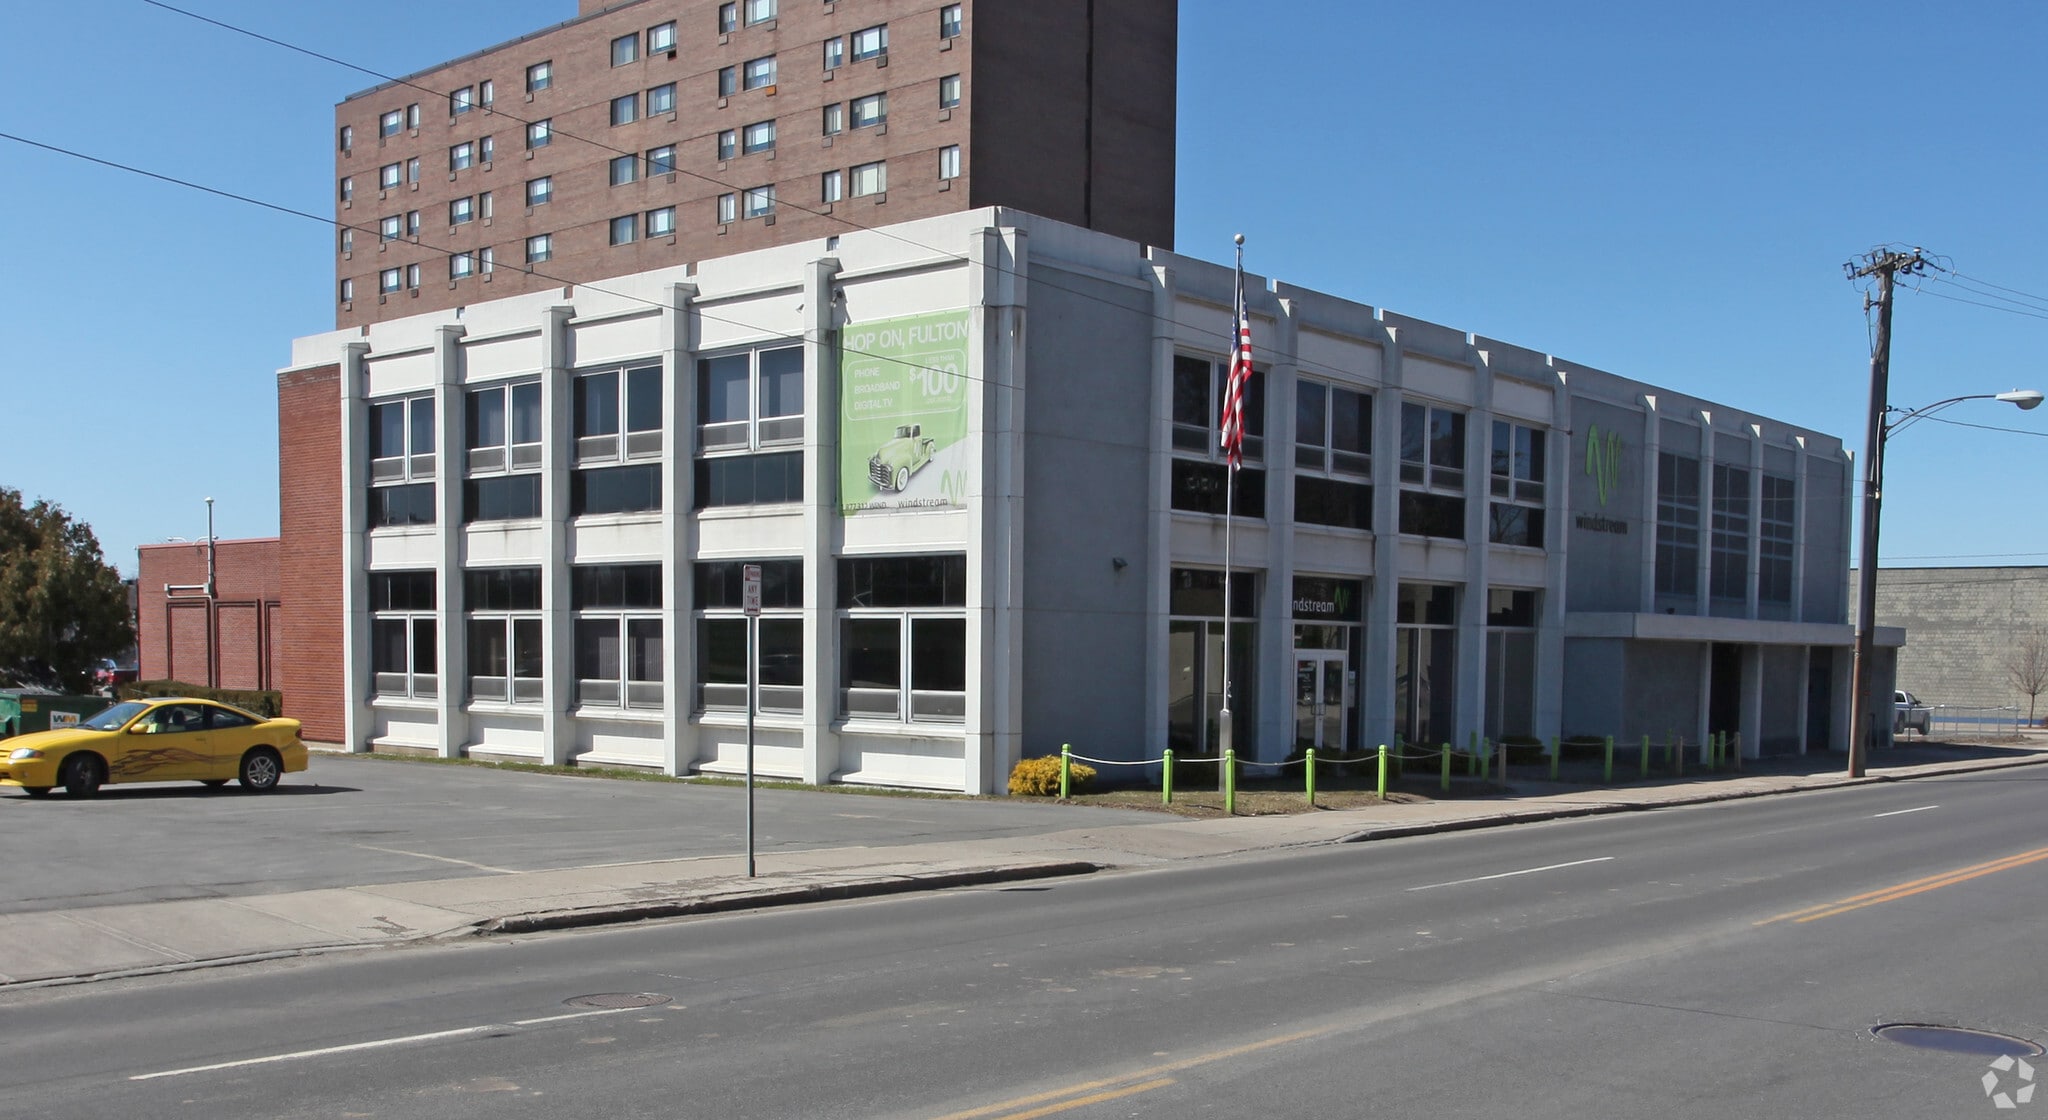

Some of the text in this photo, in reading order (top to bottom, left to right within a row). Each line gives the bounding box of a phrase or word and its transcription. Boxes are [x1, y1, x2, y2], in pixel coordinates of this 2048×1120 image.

[844, 320, 968, 351] HOP ON, FULTON
[854, 367, 880, 378] PHONE
[854, 381, 901, 395] BROADBAND
[854, 398, 893, 411] DIGITAL TV
[898, 498, 948, 509] windstream
[1576, 513, 1627, 535] windstream
[1293, 598, 1335, 613] ndstream
[53, 715, 77, 723] WM
